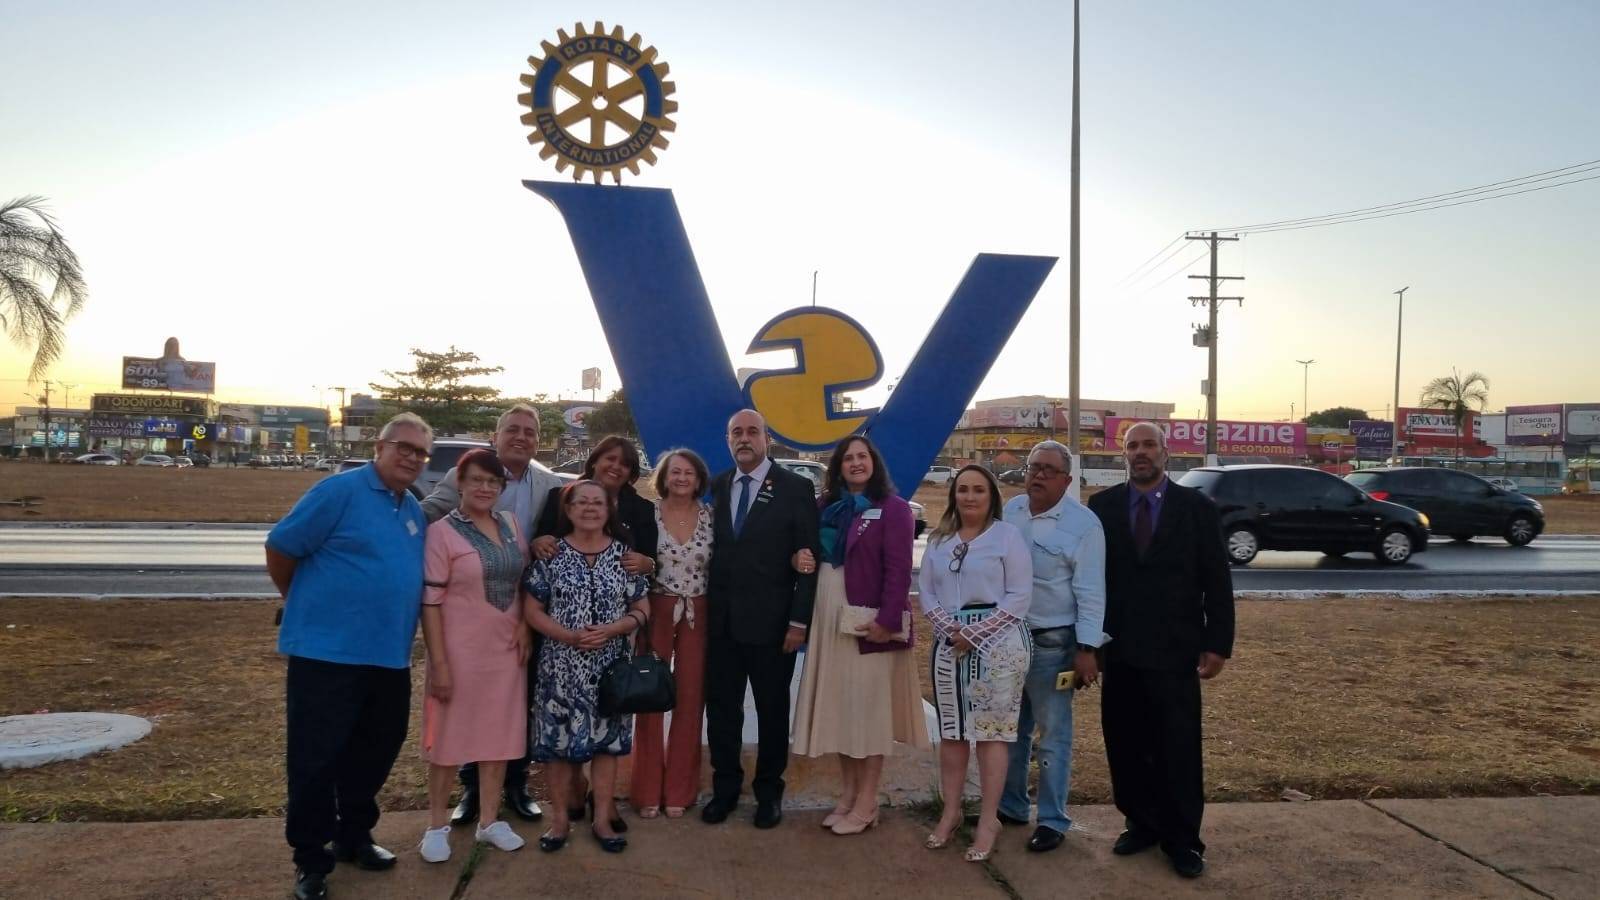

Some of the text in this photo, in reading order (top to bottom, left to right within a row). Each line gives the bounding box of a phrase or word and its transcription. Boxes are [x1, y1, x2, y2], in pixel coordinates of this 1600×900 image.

[563, 37, 639, 63] ROTARY
[538, 114, 656, 165] INTERNATIONAL
[111, 397, 184, 409] ODONTOART
[1231, 444, 1294, 455] economia
